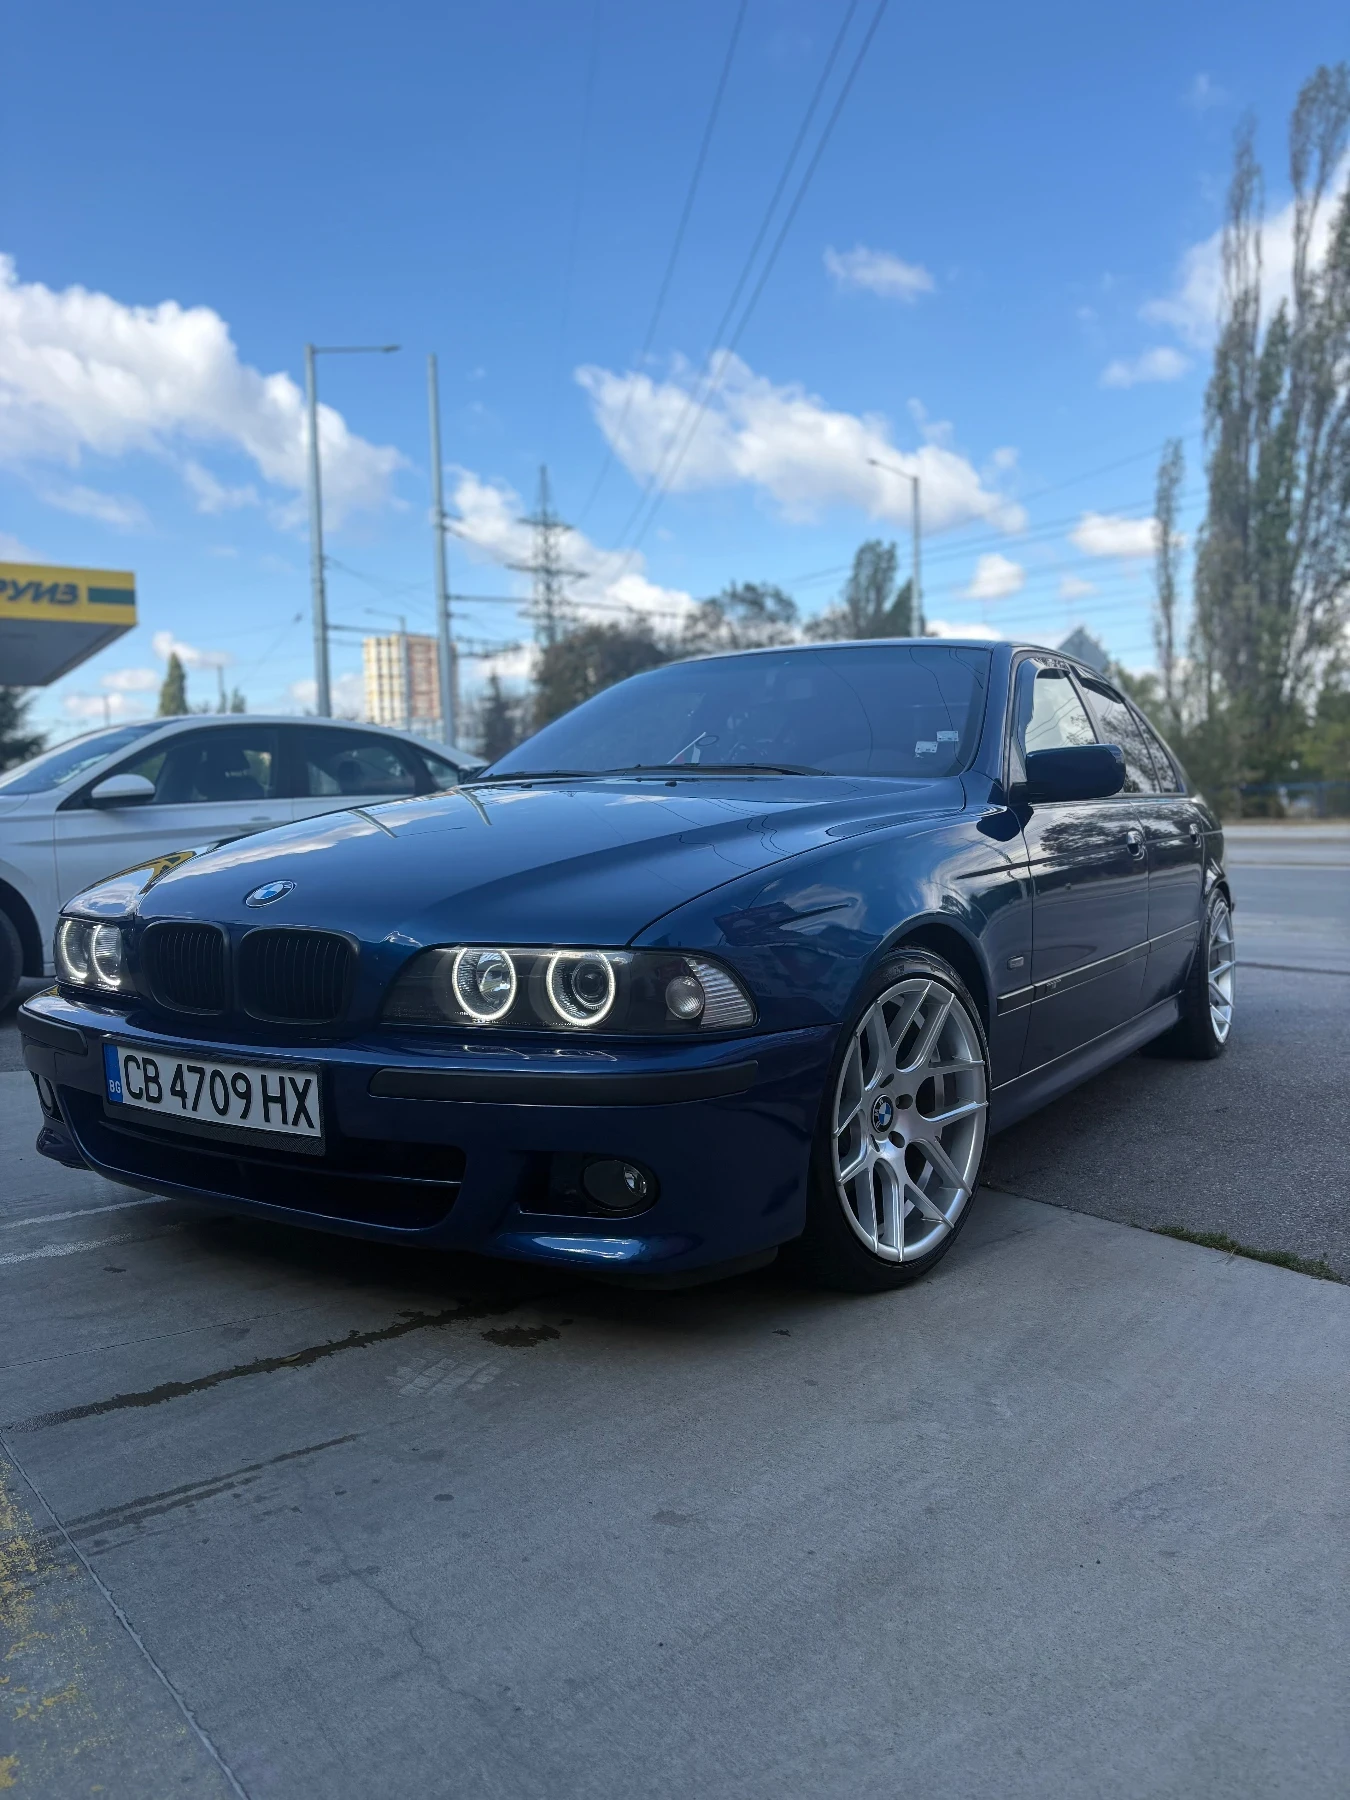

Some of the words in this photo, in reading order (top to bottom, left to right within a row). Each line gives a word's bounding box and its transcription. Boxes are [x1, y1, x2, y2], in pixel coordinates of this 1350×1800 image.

[109, 1079, 121, 1094] BG
[123, 1054, 163, 1104] CB
[170, 1063, 252, 1120] 4709
[260, 1074, 315, 1129] HX
